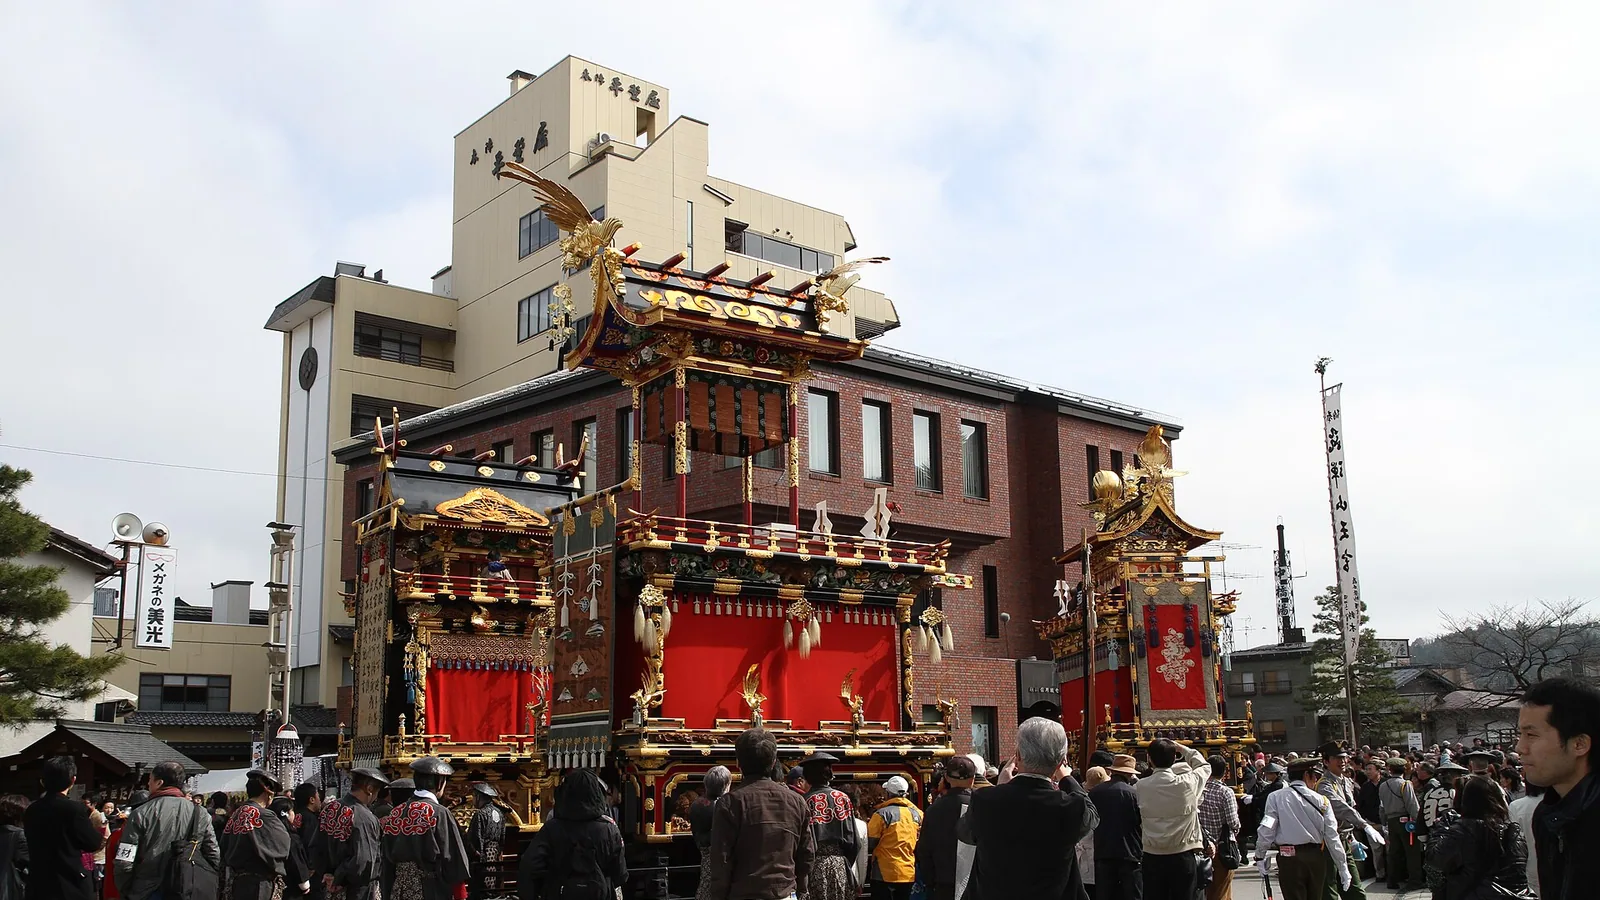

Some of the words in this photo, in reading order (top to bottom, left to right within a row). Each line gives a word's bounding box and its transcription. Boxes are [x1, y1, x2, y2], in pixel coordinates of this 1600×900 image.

[145, 562, 167, 643] メガネの美光
